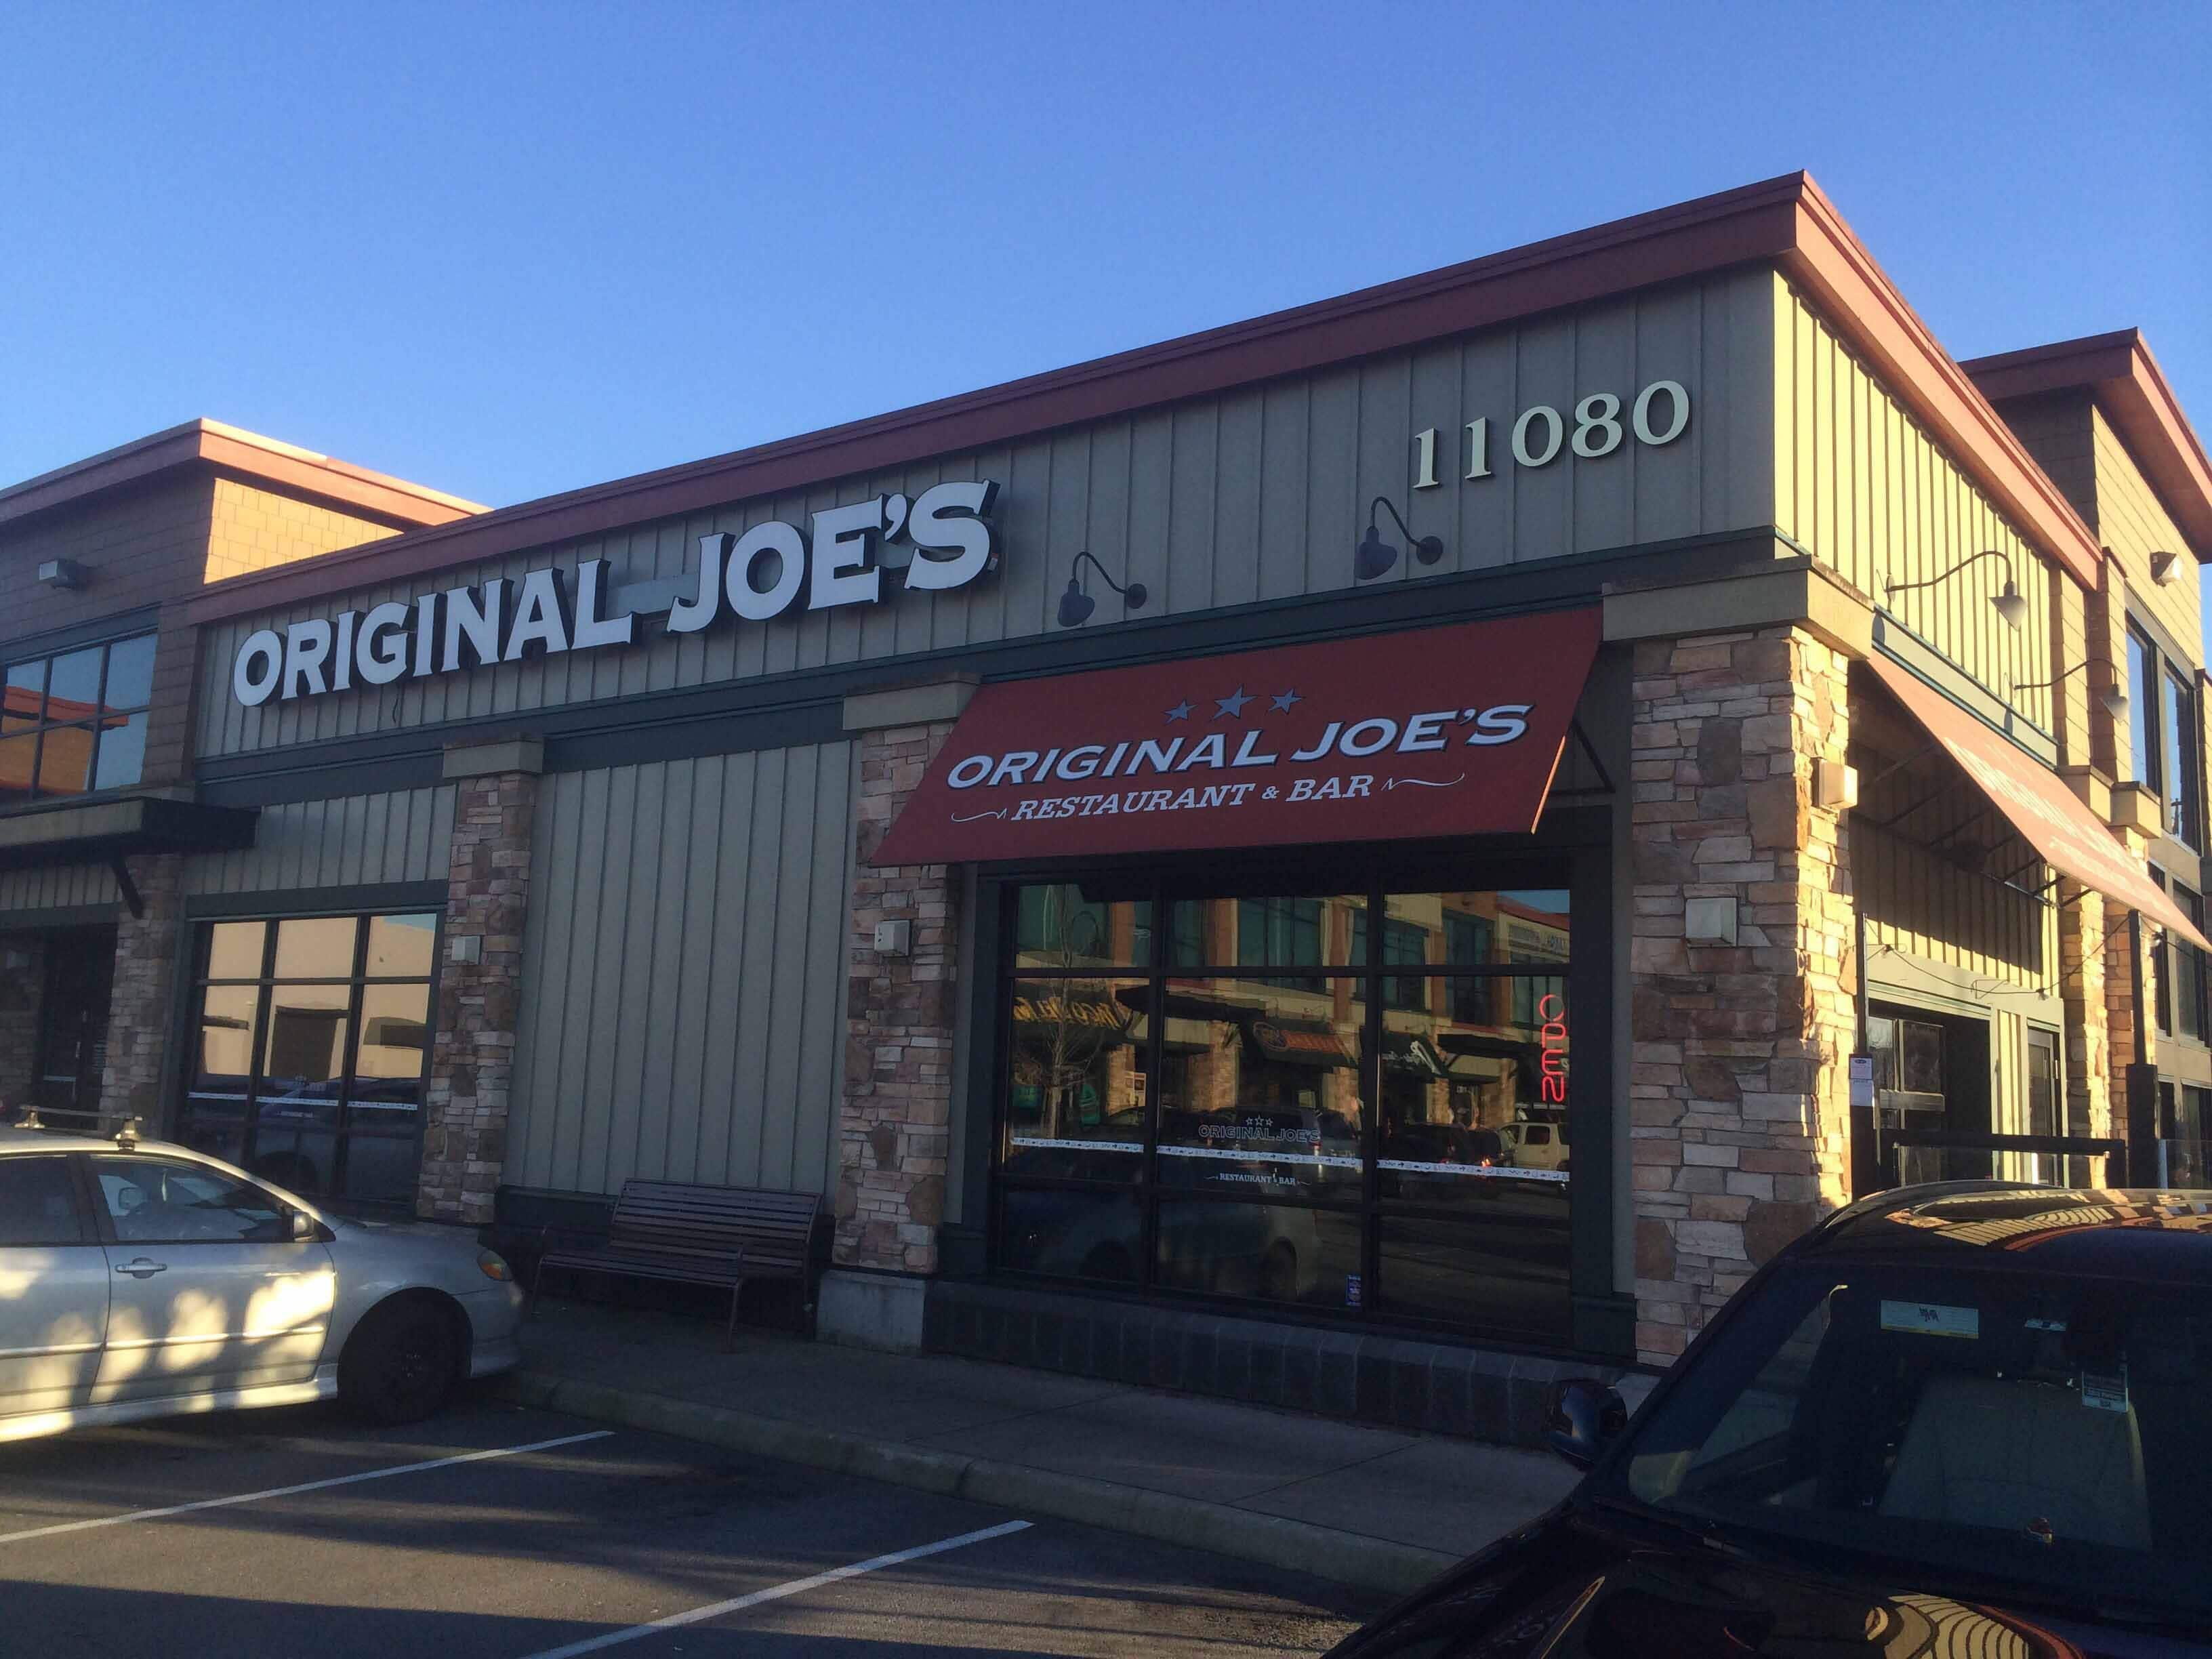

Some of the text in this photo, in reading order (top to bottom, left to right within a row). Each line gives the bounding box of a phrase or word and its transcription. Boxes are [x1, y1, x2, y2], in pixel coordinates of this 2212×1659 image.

[1413, 380, 1689, 490] 11080
[233, 478, 994, 707] ORIGINAL JOE'S
[947, 704, 1533, 789] ORIGINAL JOE'S
[1010, 775, 1374, 821] RESTAURANT & BAR
[1539, 993, 1567, 1103] OPEN
[1198, 1124, 1321, 1143] ORIGINAL JOE'S
[1220, 1172, 1271, 1183] RESTAURANT
[1279, 1177, 1295, 1185] BAR
